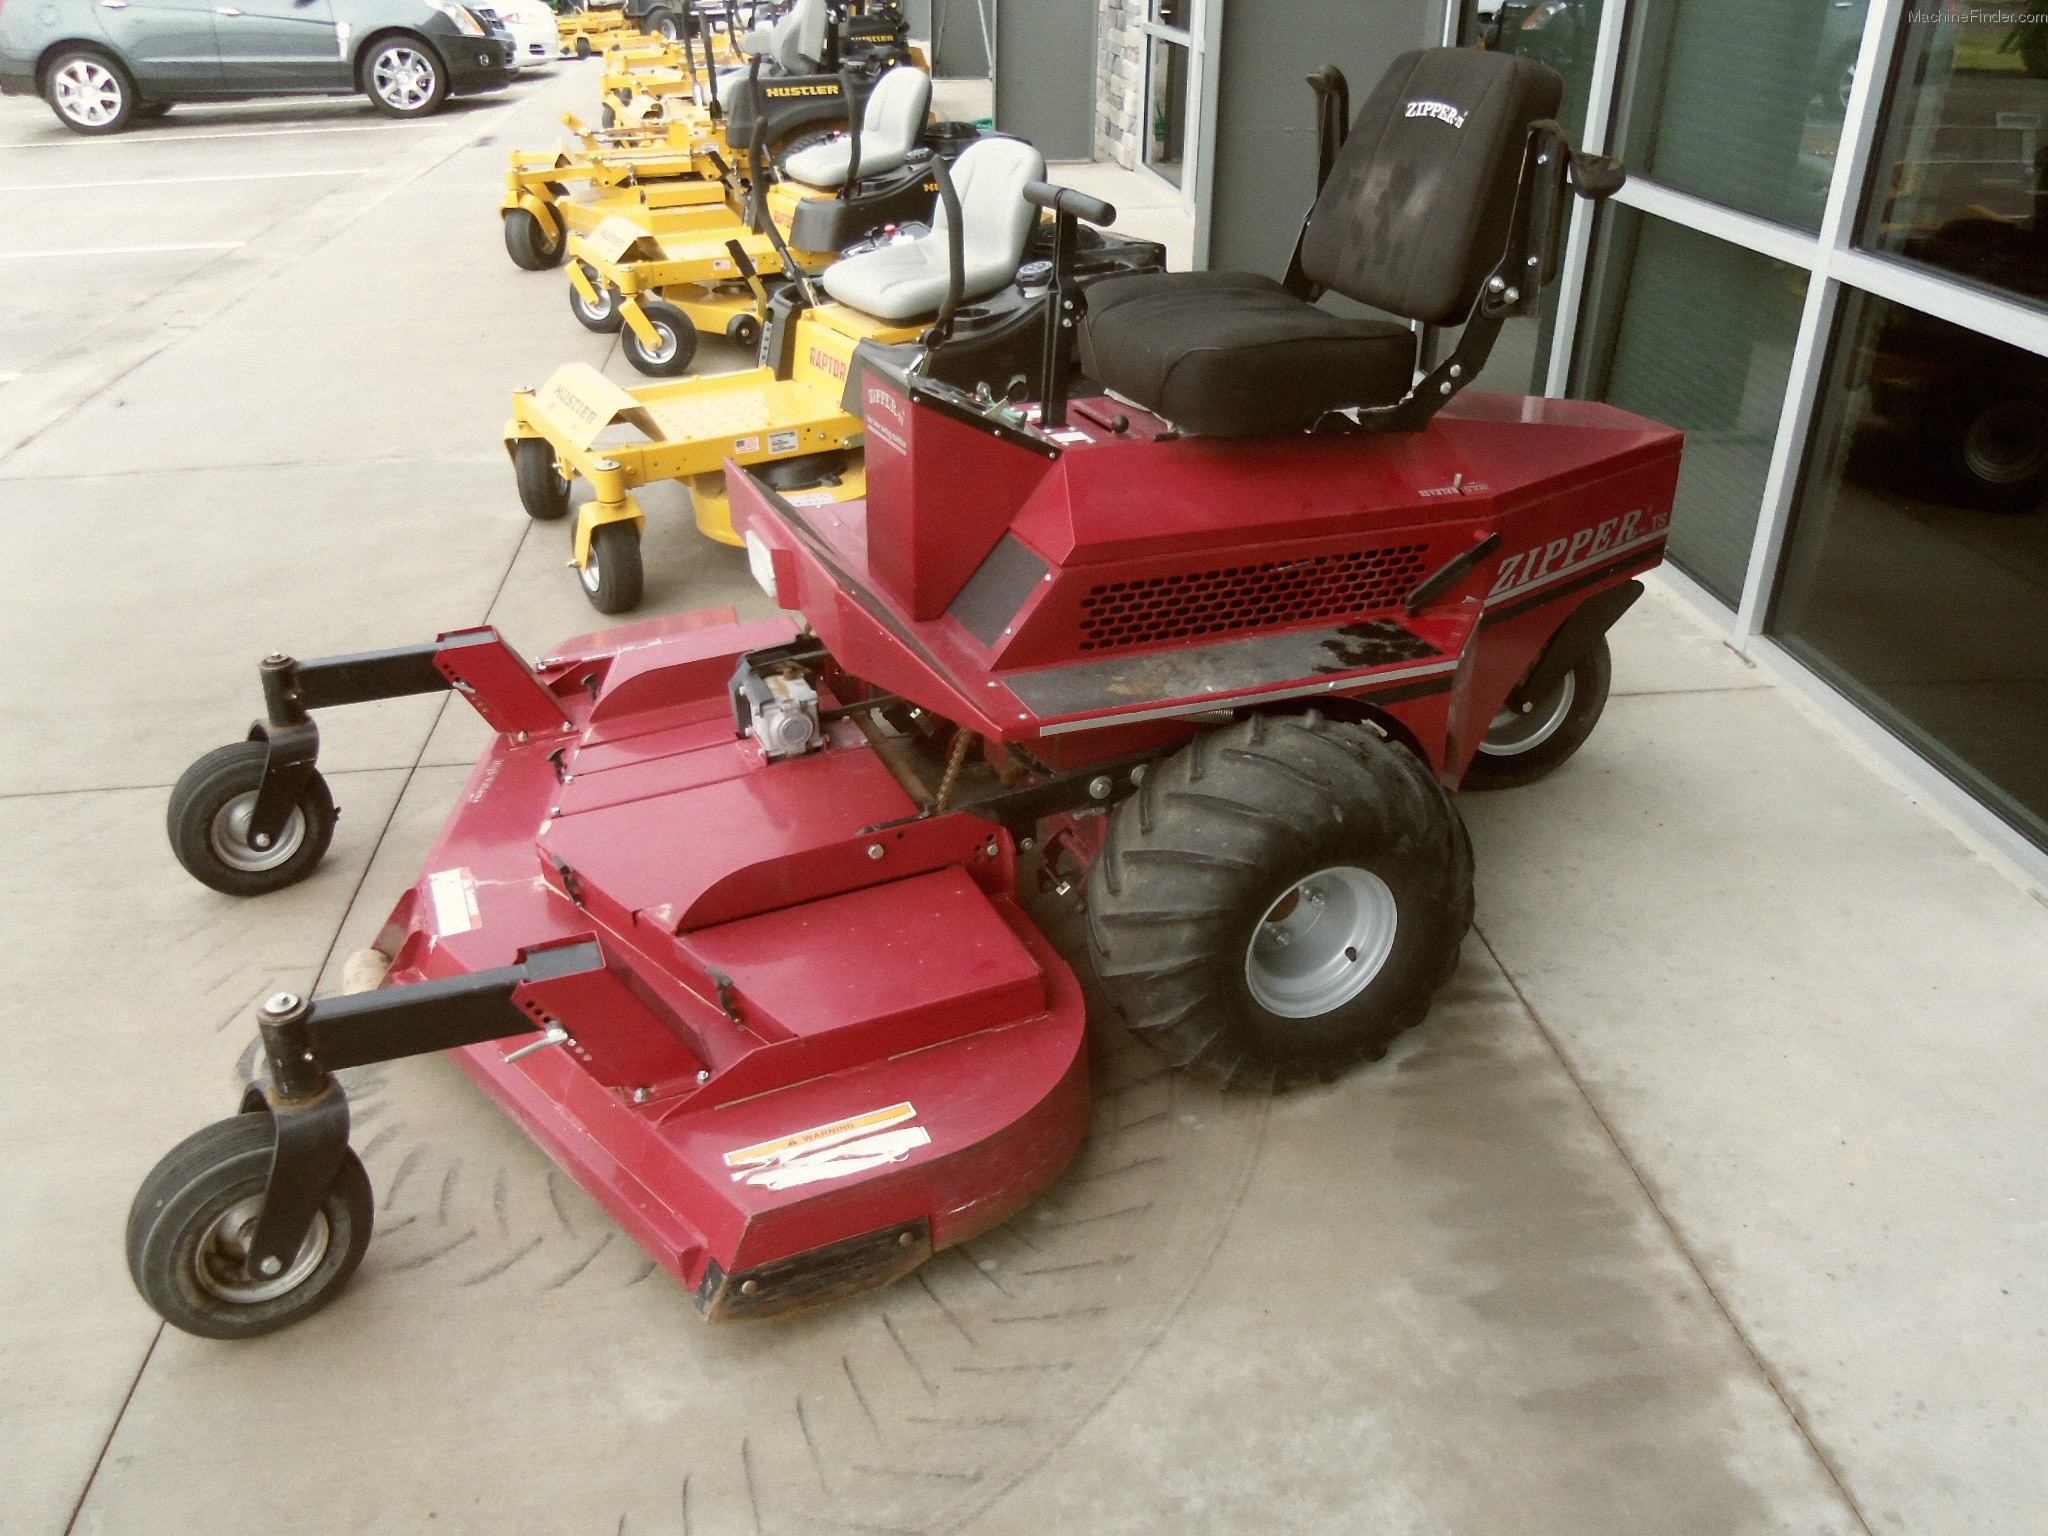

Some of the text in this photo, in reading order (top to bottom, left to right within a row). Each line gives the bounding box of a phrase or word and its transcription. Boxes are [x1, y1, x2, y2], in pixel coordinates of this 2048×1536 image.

[766, 85, 839, 97] HUSTLER
[810, 346, 847, 381] RAPTOR
[802, 1121, 855, 1142] WARNING
